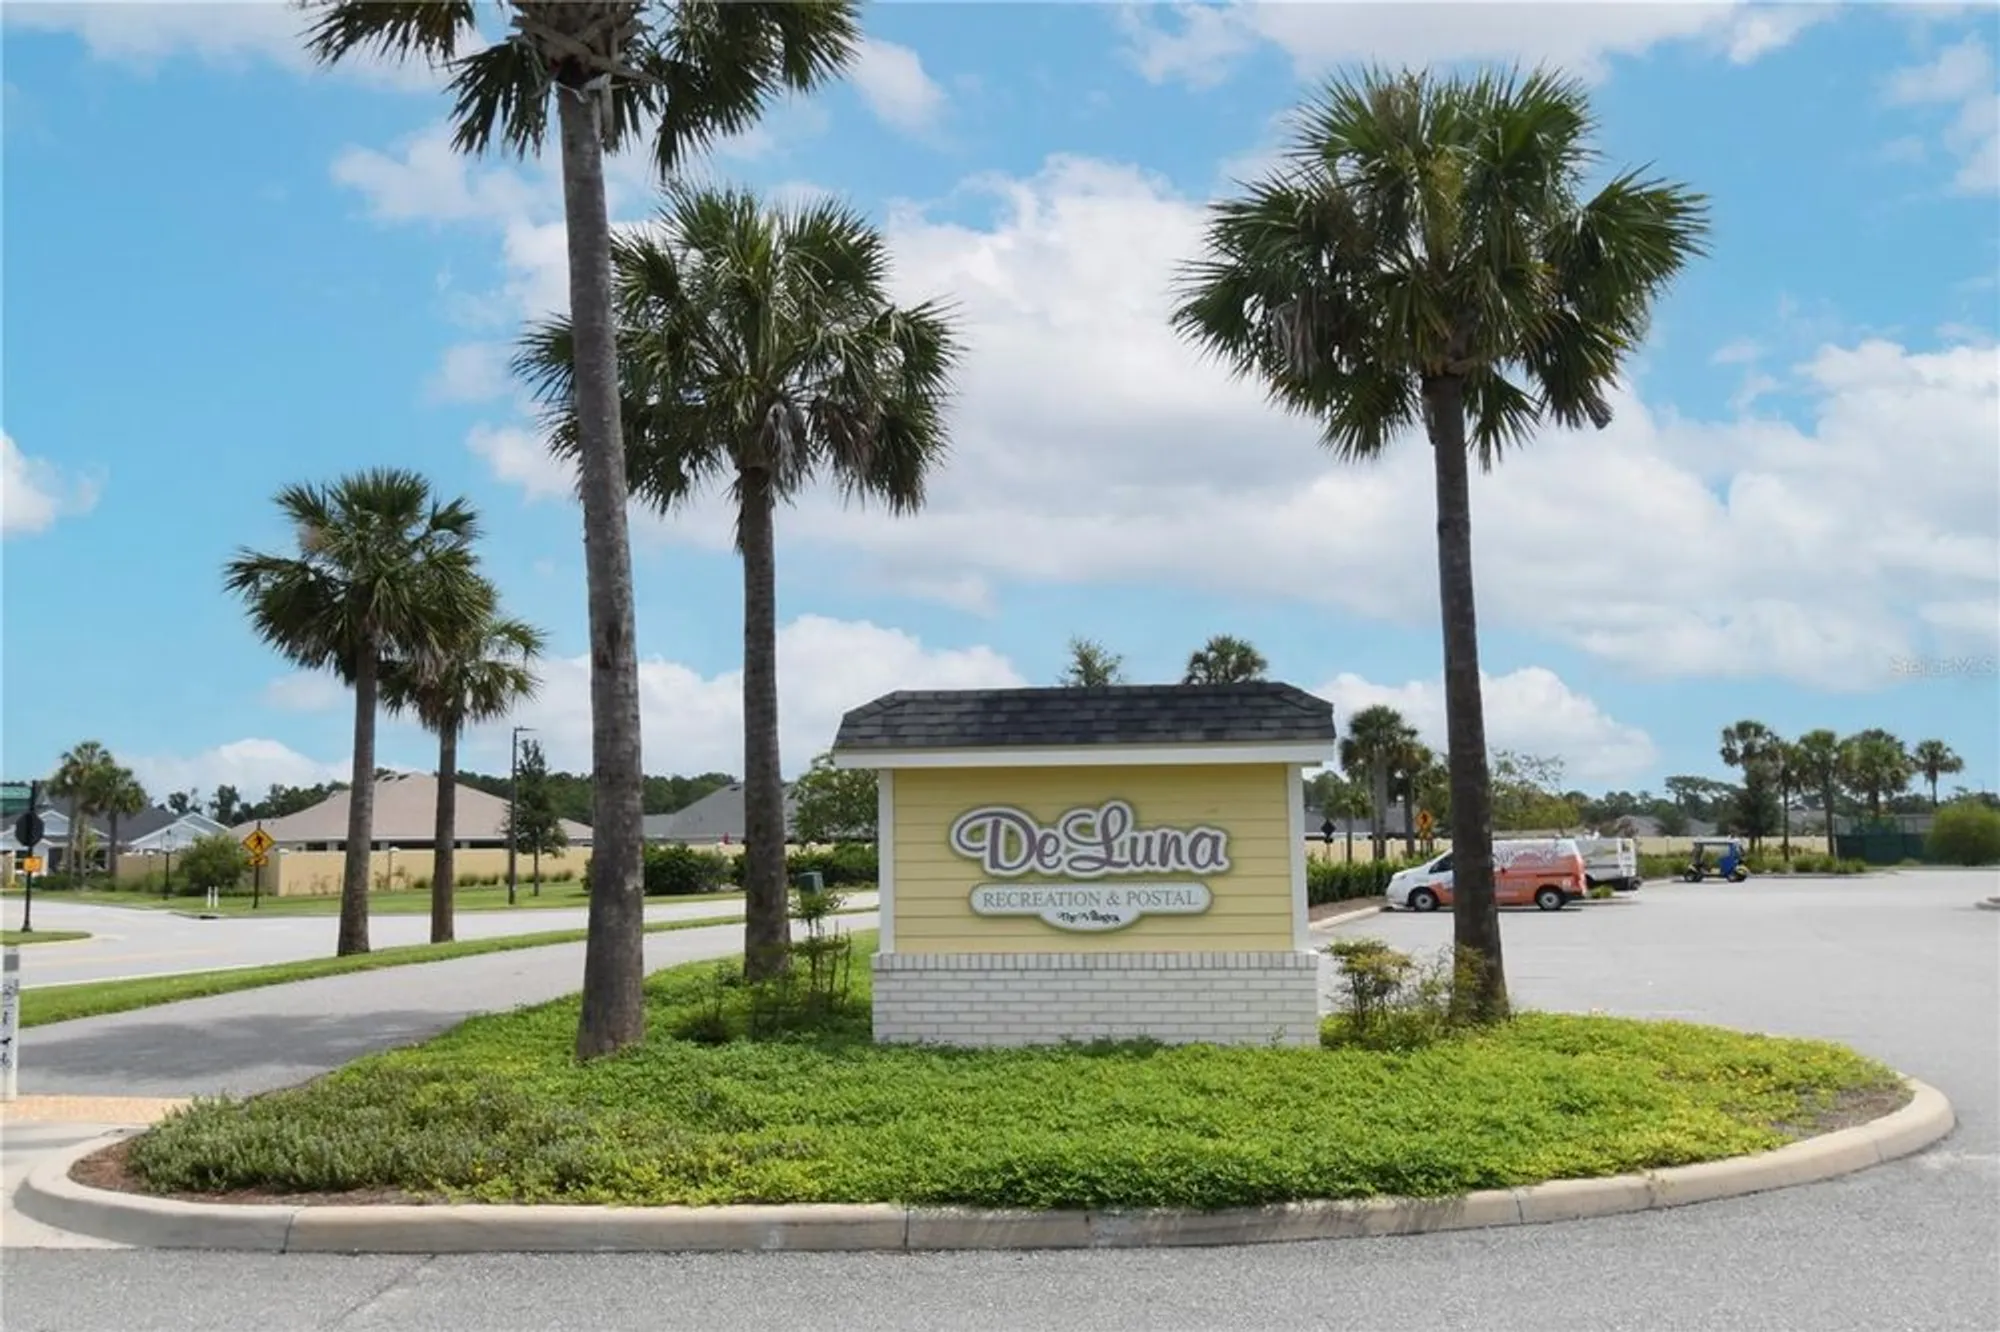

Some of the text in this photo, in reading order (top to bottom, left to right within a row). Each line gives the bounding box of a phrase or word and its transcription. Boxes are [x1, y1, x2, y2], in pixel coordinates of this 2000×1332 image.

[983, 890, 1199, 908] RECREATION & POSTAL
